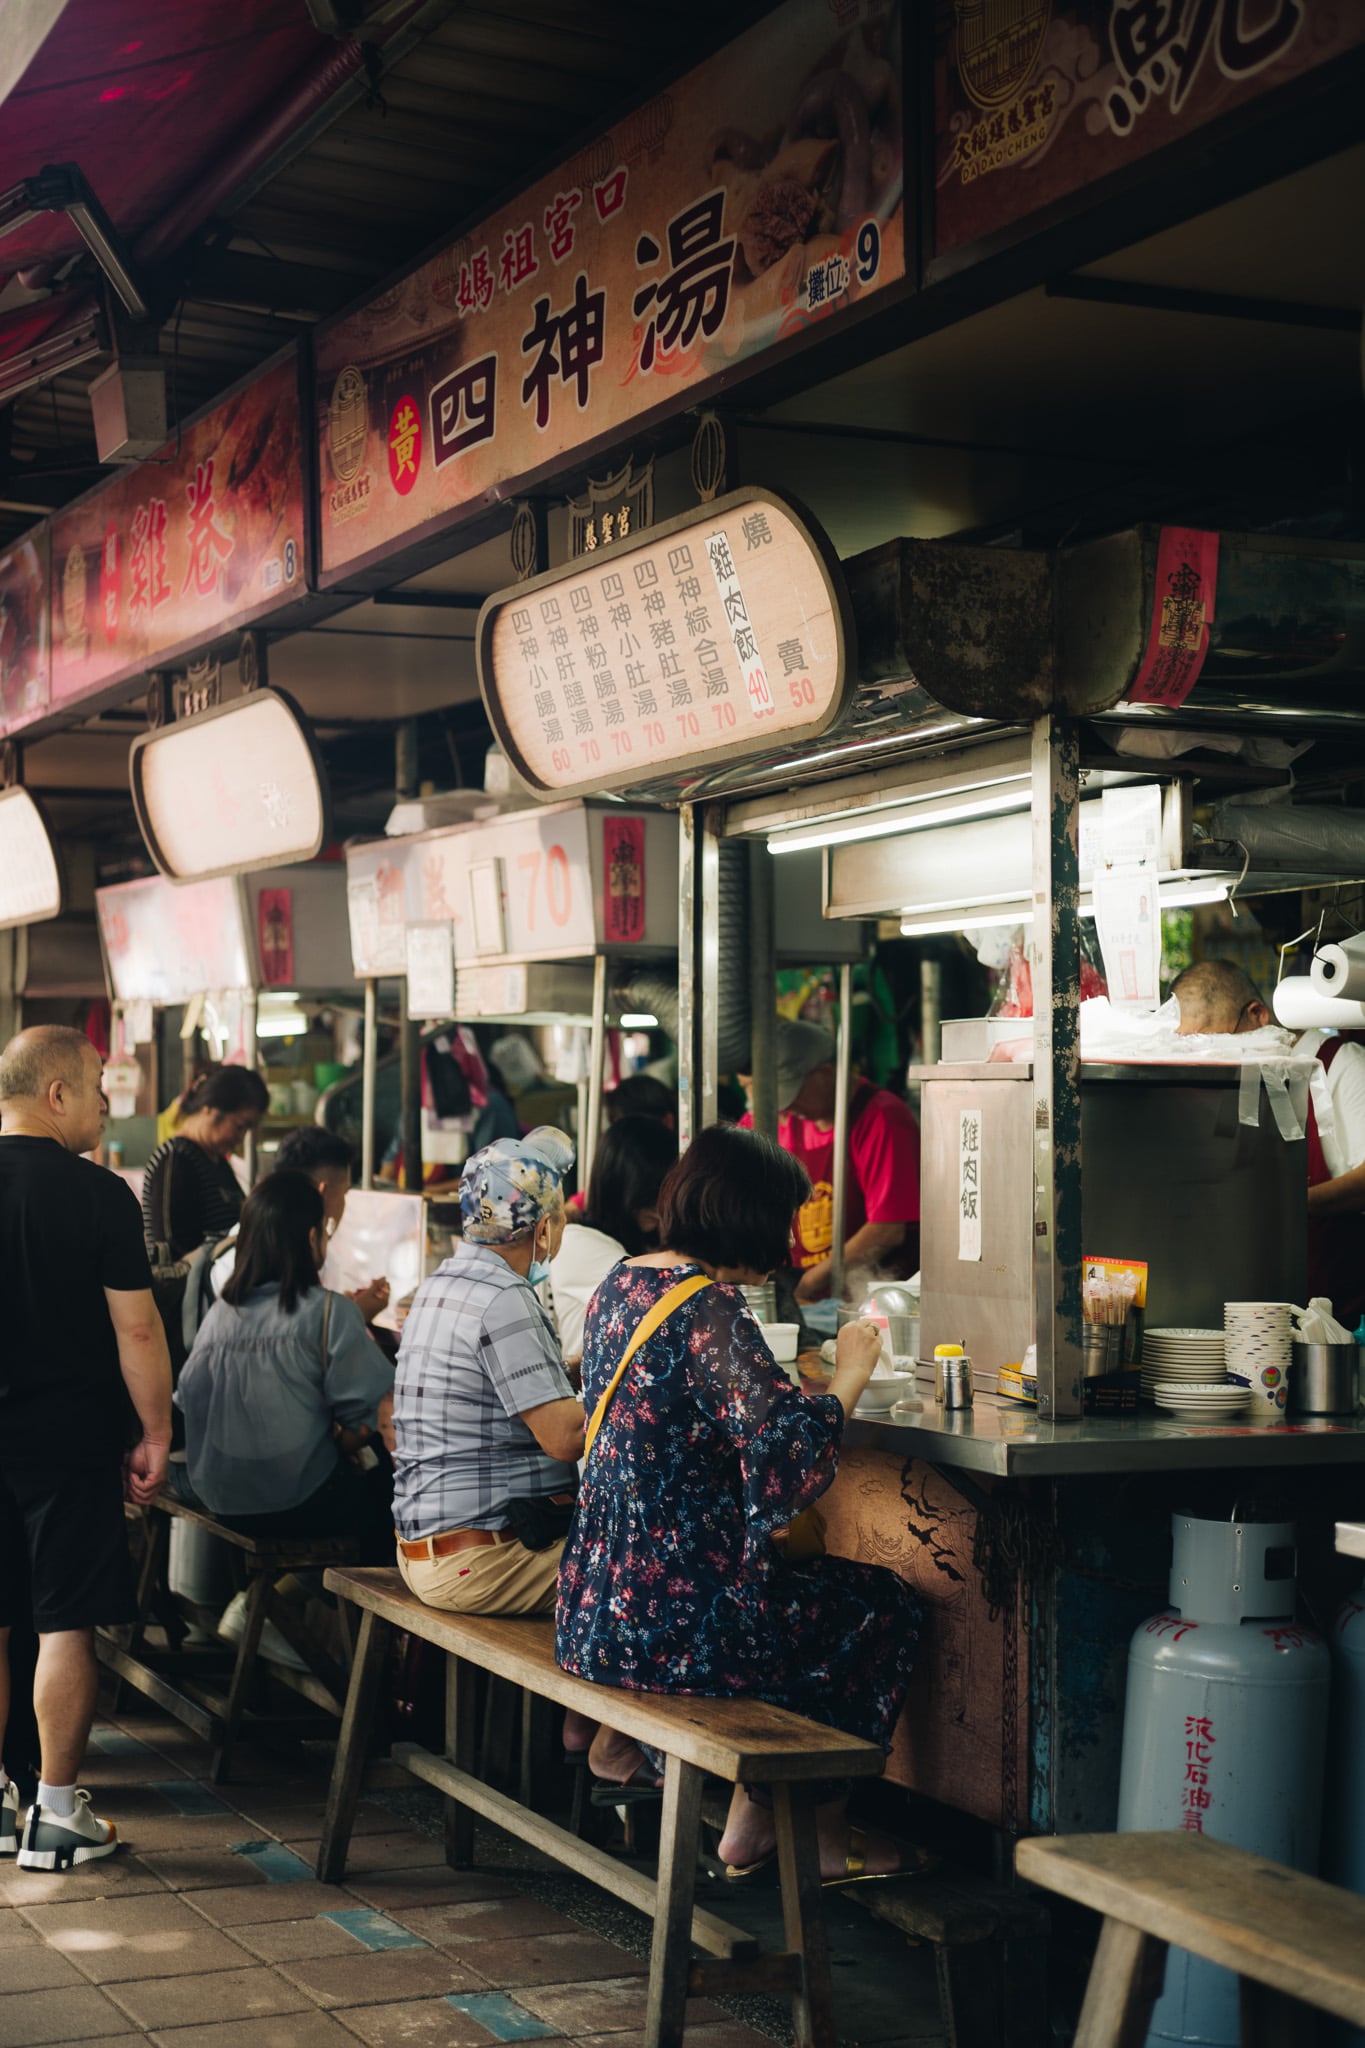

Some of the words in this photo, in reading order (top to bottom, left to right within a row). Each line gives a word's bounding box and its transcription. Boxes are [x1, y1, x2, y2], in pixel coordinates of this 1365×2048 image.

[962, 163, 978, 182] DA
[981, 150, 1004, 171] DAO
[1006, 127, 1047, 157] CHENG
[456, 170, 628, 314] 媽祖宮口
[430, 190, 737, 468] 四神湯
[390, 406, 420, 481] 黃
[511, 608, 564, 745] 四神小腸湯
[552, 747, 571, 772] 60
[569, 585, 625, 727] 四神粉腸湯
[610, 730, 632, 756] 70
[600, 572, 658, 718] 四神小肚湯
[643, 722, 665, 748] 70
[633, 559, 693, 709] 四神豬肚湯
[676, 711, 700, 738] 70
[667, 544, 729, 699] 四神綜合湯
[711, 701, 737, 730] 70
[741, 512, 809, 677] 燒賣
[788, 678, 815, 708] 50
[748, 668, 769, 705] 40
[580, 738, 600, 763] 70
[516, 844, 572, 931] 70
